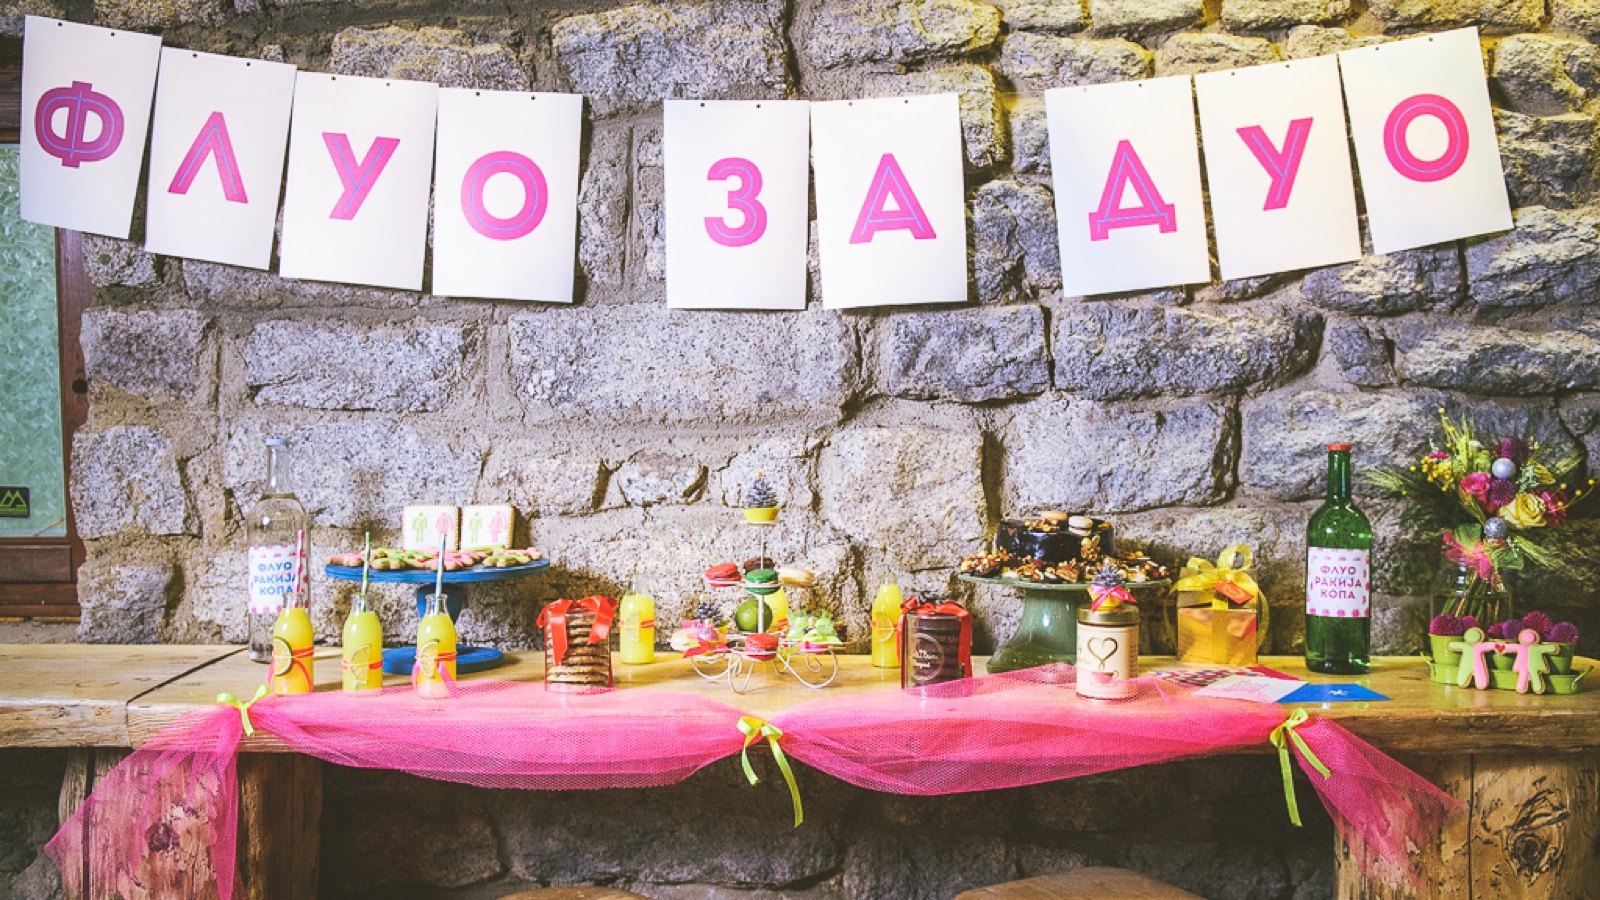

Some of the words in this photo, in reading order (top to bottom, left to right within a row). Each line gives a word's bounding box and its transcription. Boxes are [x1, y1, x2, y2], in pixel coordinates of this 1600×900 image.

[35, 80, 549, 241] ФЛУО
[703, 153, 937, 248] ЗА
[1088, 93, 1470, 241] ДУО
[258, 561, 292, 571] ФЛУО
[1320, 565, 1357, 576] ФЛУО
[1315, 576, 1362, 588] РАКИЈА
[1320, 589, 1356, 599] КОПА
